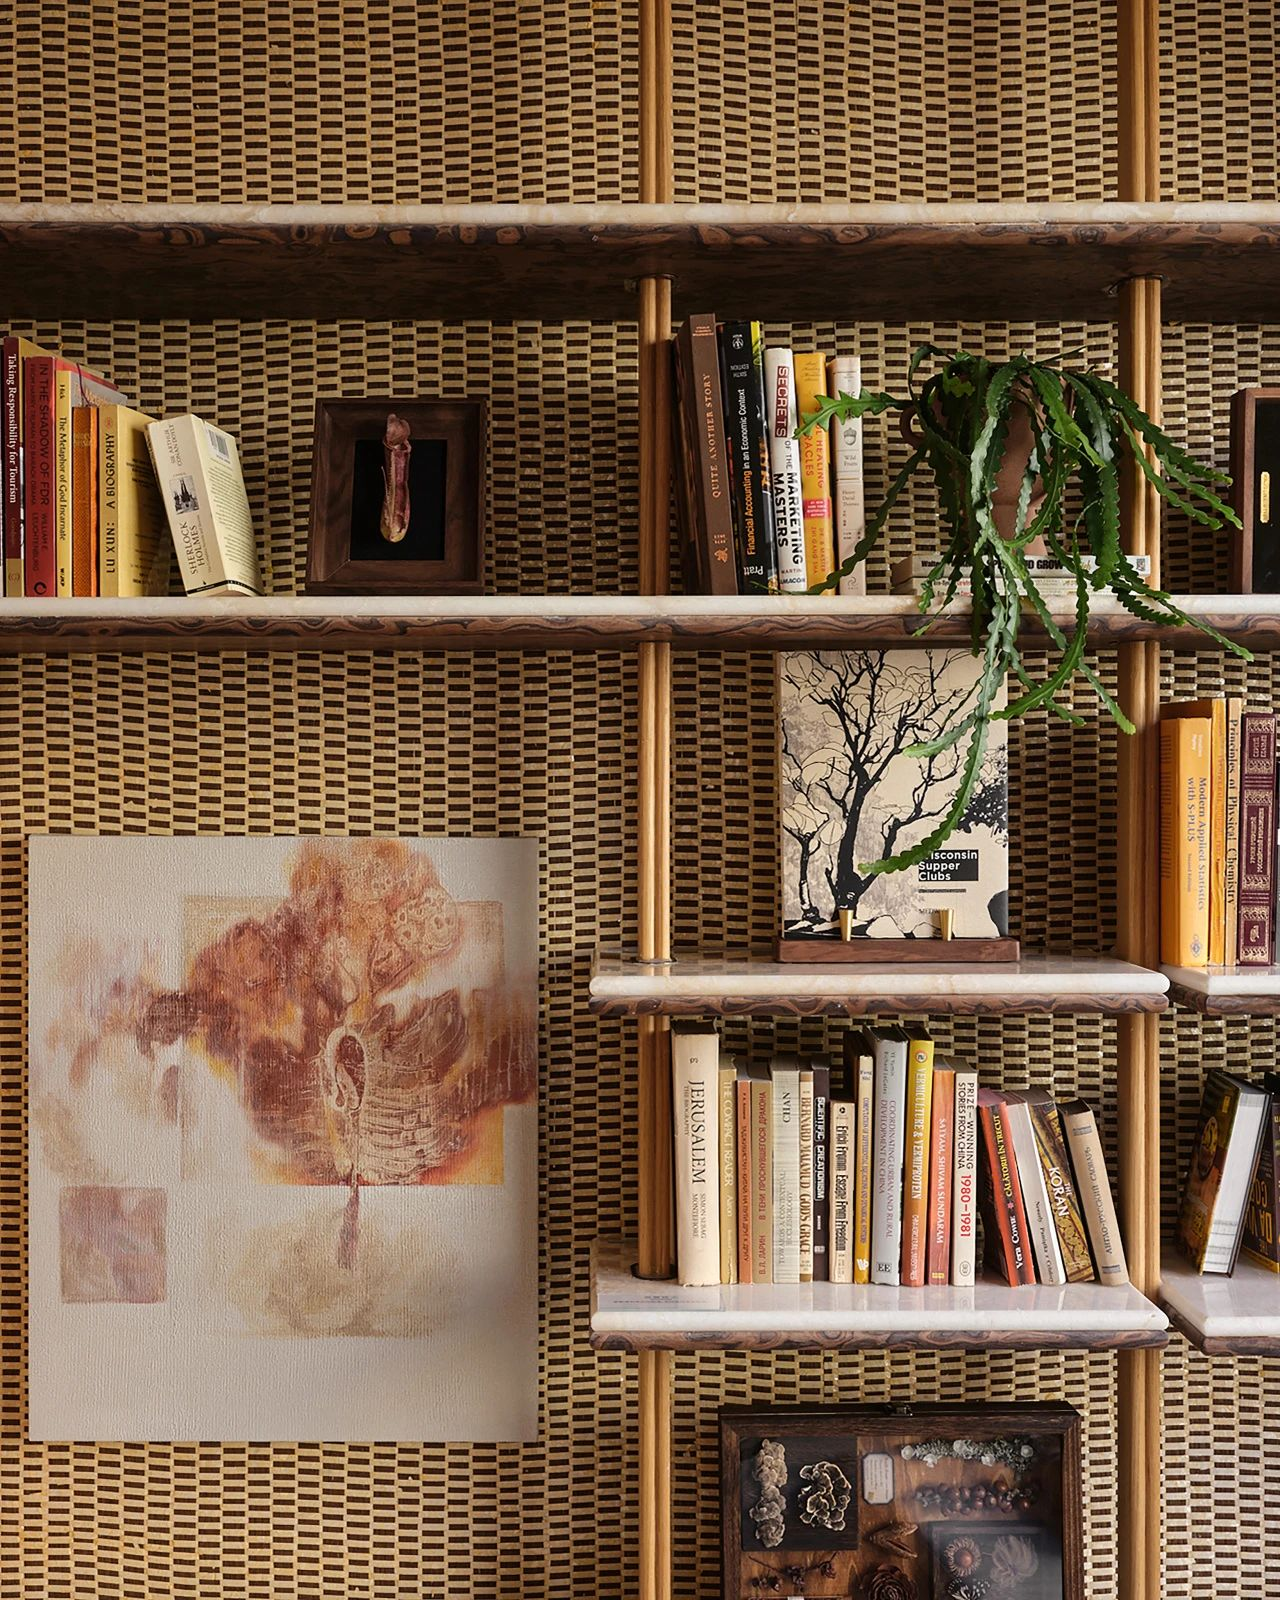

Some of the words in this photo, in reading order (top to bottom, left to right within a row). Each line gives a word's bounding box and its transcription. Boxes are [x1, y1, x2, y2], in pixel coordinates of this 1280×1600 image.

[6, 354, 17, 385] Taking
[40, 364, 50, 376] IN
[40, 379, 50, 401] THE
[702, 373, 713, 408] STORY
[736, 389, 747, 415] Context
[776, 366, 788, 438] SECRETS
[7, 387, 18, 449] Responsibility
[40, 404, 50, 457] SHADOW
[739, 416, 750, 450] Economic
[58, 432, 68, 472] Metaphor
[706, 411, 718, 461] ANOTHER
[784, 440, 792, 452] OF
[10, 451, 19, 462] for
[40, 463, 50, 478] OF
[106, 433, 116, 496] BIOGRAPHY
[743, 451, 750, 462] an
[816, 440, 824, 488] HEALING
[10, 466, 18, 503] Tourism
[40, 482, 50, 505] FDR
[59, 484, 67, 502] God
[60, 474, 67, 483] of
[711, 465, 722, 498] QUITE
[742, 471, 754, 516] Accounting
[106, 500, 116, 509] A
[773, 473, 788, 548] MASTERS
[787, 472, 803, 565] MARKETING
[106, 522, 116, 552] XUN:
[179, 521, 198, 575] SHERLOCK
[189, 525, 206, 571] HOLMES
[746, 518, 756, 555] Financial
[106, 559, 116, 573] LU
[743, 567, 764, 578] Pratt
[1228, 720, 1238, 772] Principles
[1186, 777, 1196, 800] with
[1198, 778, 1207, 817] Modern
[1228, 779, 1238, 790] of
[1186, 804, 1196, 842] S-PLUS
[1228, 796, 1238, 840] Physical
[925, 850, 978, 860] isconsin
[1196, 820, 1206, 862] Applied
[918, 862, 960, 872] Supper
[918, 872, 952, 880] Clubs
[1228, 848, 1238, 904] Chemistry
[1198, 864, 1206, 912] Statistics
[724, 1080, 734, 1098] THE
[912, 1069, 926, 1130] VERMICULTURE
[958, 1082, 966, 1114] STORIES
[758, 1092, 766, 1125] ДРАКОНА
[782, 1092, 791, 1123] CHAN
[800, 1097, 812, 1141] BERNARD
[816, 1097, 826, 1140] SCIENTIFIC
[689, 1080, 706, 1184] JERUSALEM
[724, 1100, 734, 1148] COMPACT
[836, 1126, 848, 1144] Erich
[880, 1100, 888, 1156] DEVELOPMENT
[887, 1100, 896, 1162] COORDINATING
[938, 1118, 946, 1154] SATYAM,
[958, 1115, 966, 1140] FROM
[993, 1114, 1004, 1140] TRECUT
[724, 1150, 734, 1186] READER
[758, 1126, 766, 1190] ПРОСНУВШЕГОСЯ
[800, 1144, 812, 1189] MALAMUD
[836, 1146, 848, 1171] Fromm
[879, 1158, 886, 1166] IN
[910, 1140, 923, 1200] VERMIPROTEIN
[958, 1142, 966, 1170] CHINA
[1084, 1146, 1097, 1182] СЛОВАРЬ
[816, 1145, 825, 1200] CREATIONISM
[834, 1174, 848, 1200] Escape
[878, 1167, 886, 1194] CHINA
[886, 1164, 896, 1192] URBAN
[726, 1194, 734, 1216] Aaron
[758, 1194, 766, 1212] ТЕНИ
[886, 1192, 894, 1211] AND
[1048, 1166, 1070, 1216] KORAN
[1064, 1182, 1072, 1196] THE
[800, 1194, 812, 1220] GOD'S
[836, 1200, 848, 1220] From
[936, 1192, 945, 1244] SUNDARAM
[800, 1222, 812, 1254] GRACE
[836, 1220, 848, 1250] Freedom
[886, 1212, 894, 1238] RURAL
[758, 1236, 766, 1259] ЛАРИН
[1014, 1247, 1024, 1268] Vera
